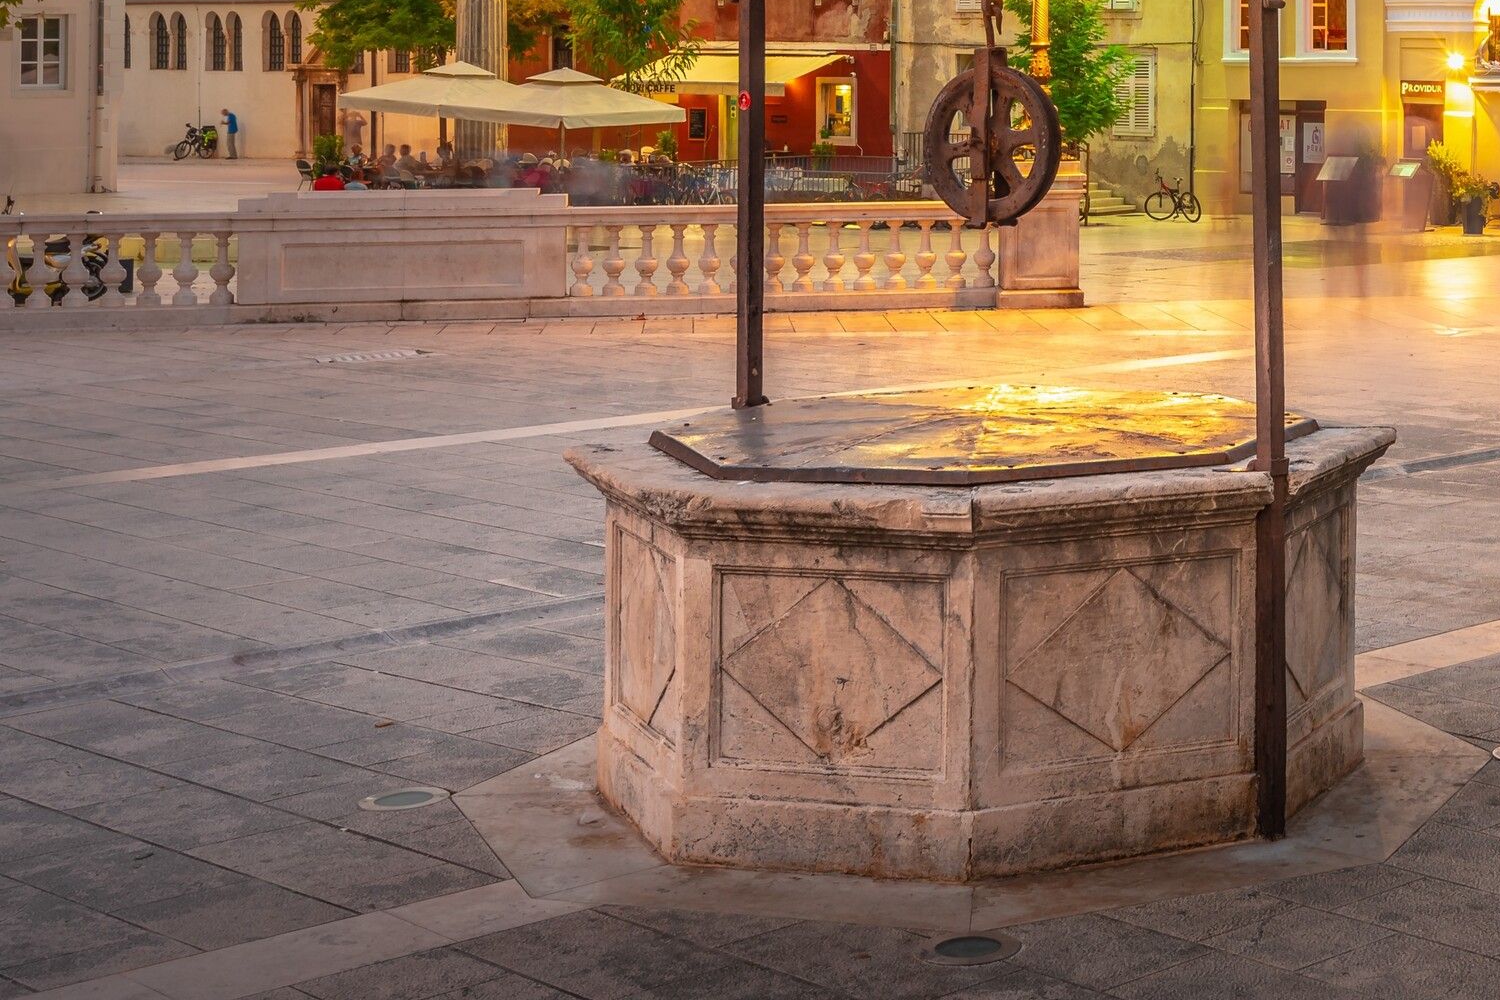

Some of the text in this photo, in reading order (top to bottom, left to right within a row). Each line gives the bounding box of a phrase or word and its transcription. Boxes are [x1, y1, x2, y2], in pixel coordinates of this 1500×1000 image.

[625, 84, 676, 94] OVI CAFFE
[1401, 82, 1442, 95] PROVIDUR
